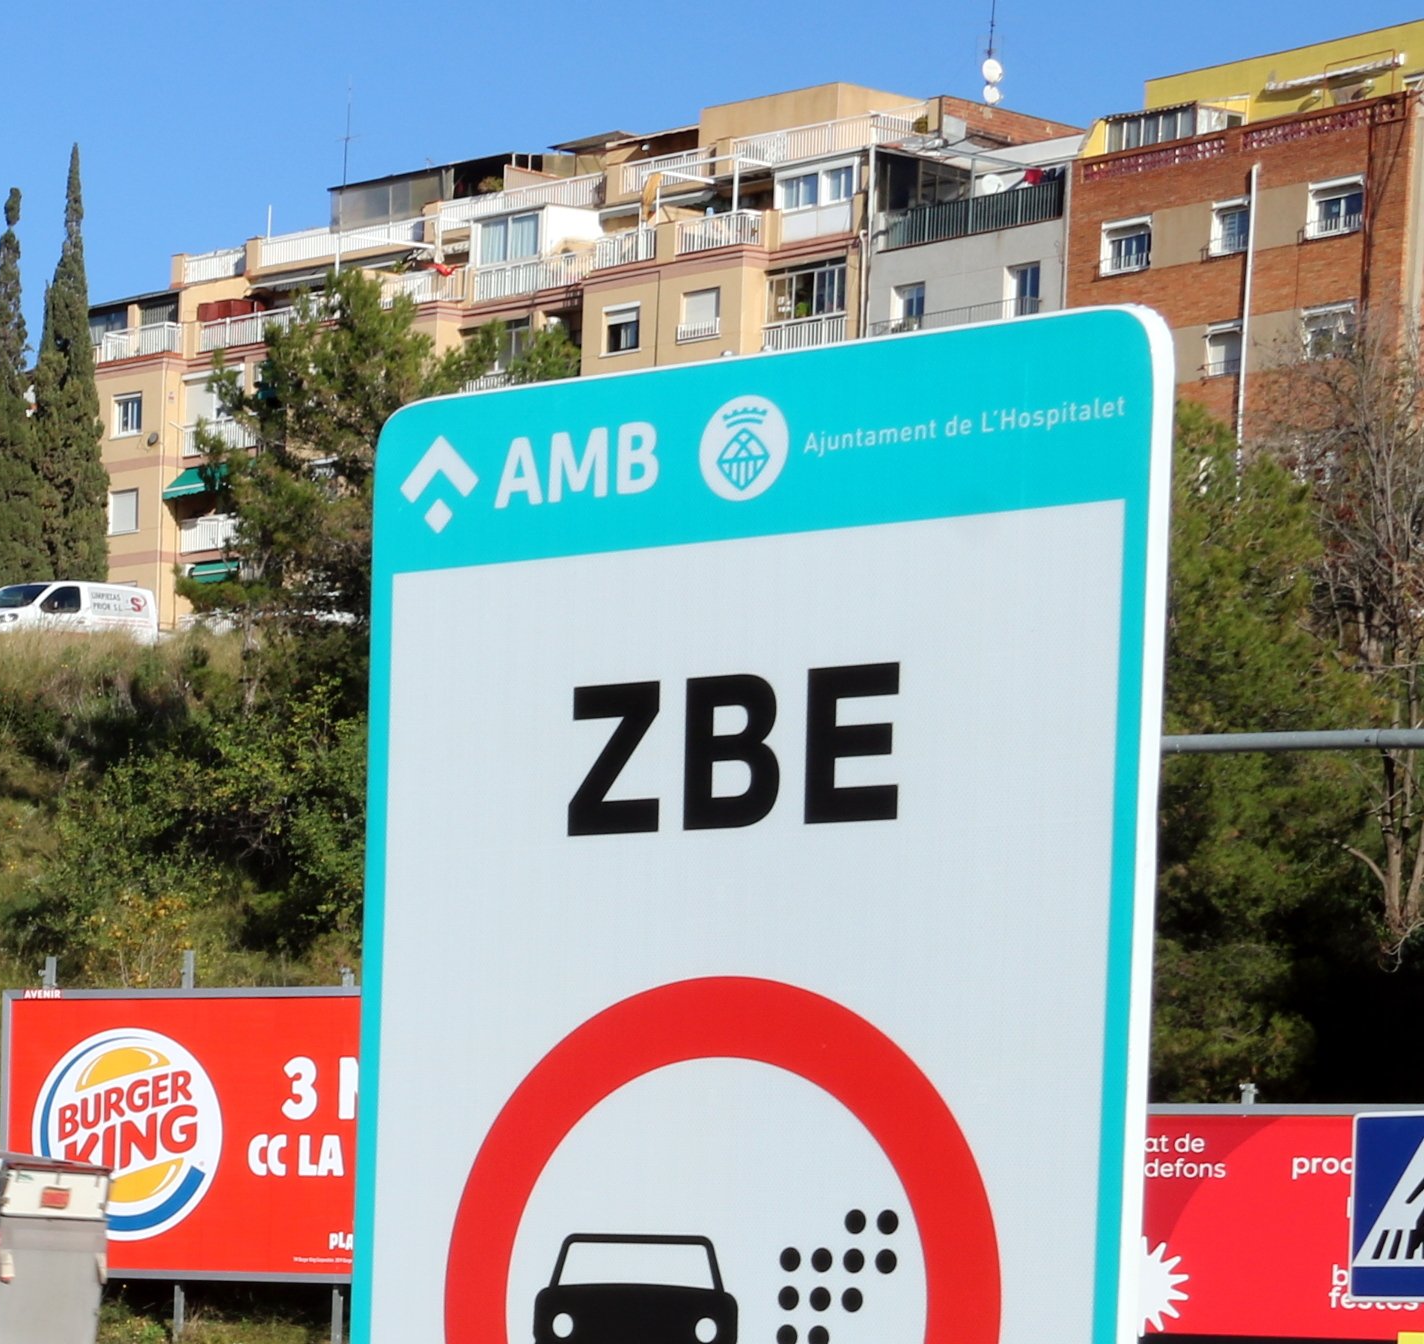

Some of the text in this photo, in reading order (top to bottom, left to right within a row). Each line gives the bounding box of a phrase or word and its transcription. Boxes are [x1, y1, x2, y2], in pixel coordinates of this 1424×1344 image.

[803, 396, 1126, 457] Ajuntament de L'Hospitalet
[494, 421, 659, 509] AMB
[567, 661, 901, 836] ZBE
[24, 989, 61, 999] AVENIR
[58, 1070, 193, 1141] BURGER
[281, 1056, 319, 1121] 3
[64, 1105, 199, 1170] KING
[247, 1134, 344, 1177] CC LA
[1174, 1133, 1205, 1153] de
